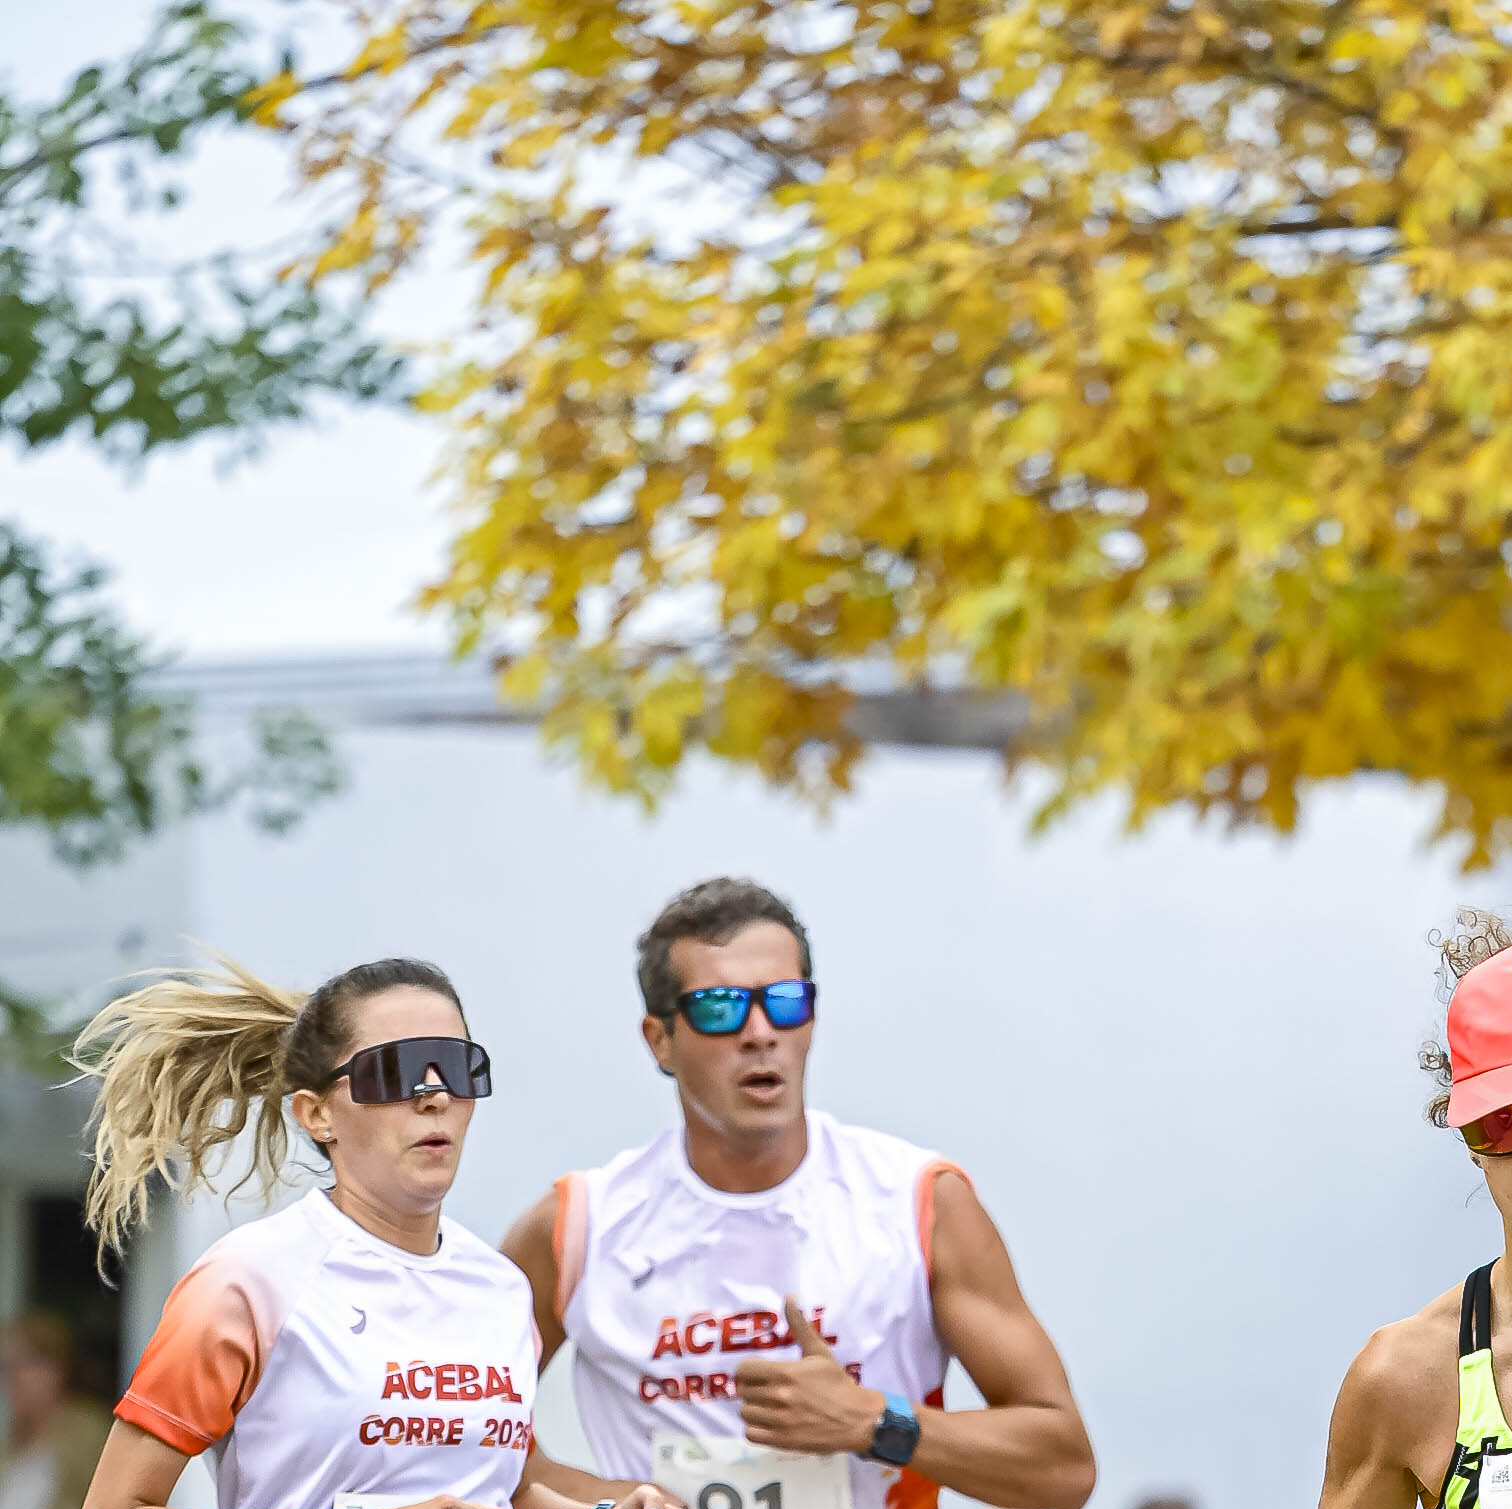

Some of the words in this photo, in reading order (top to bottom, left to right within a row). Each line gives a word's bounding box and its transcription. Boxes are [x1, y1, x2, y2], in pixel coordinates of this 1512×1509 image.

[380, 1360, 523, 1405] ACEBAL
[639, 1372, 737, 1403] CORR
[358, 1414, 464, 1446] CORRE
